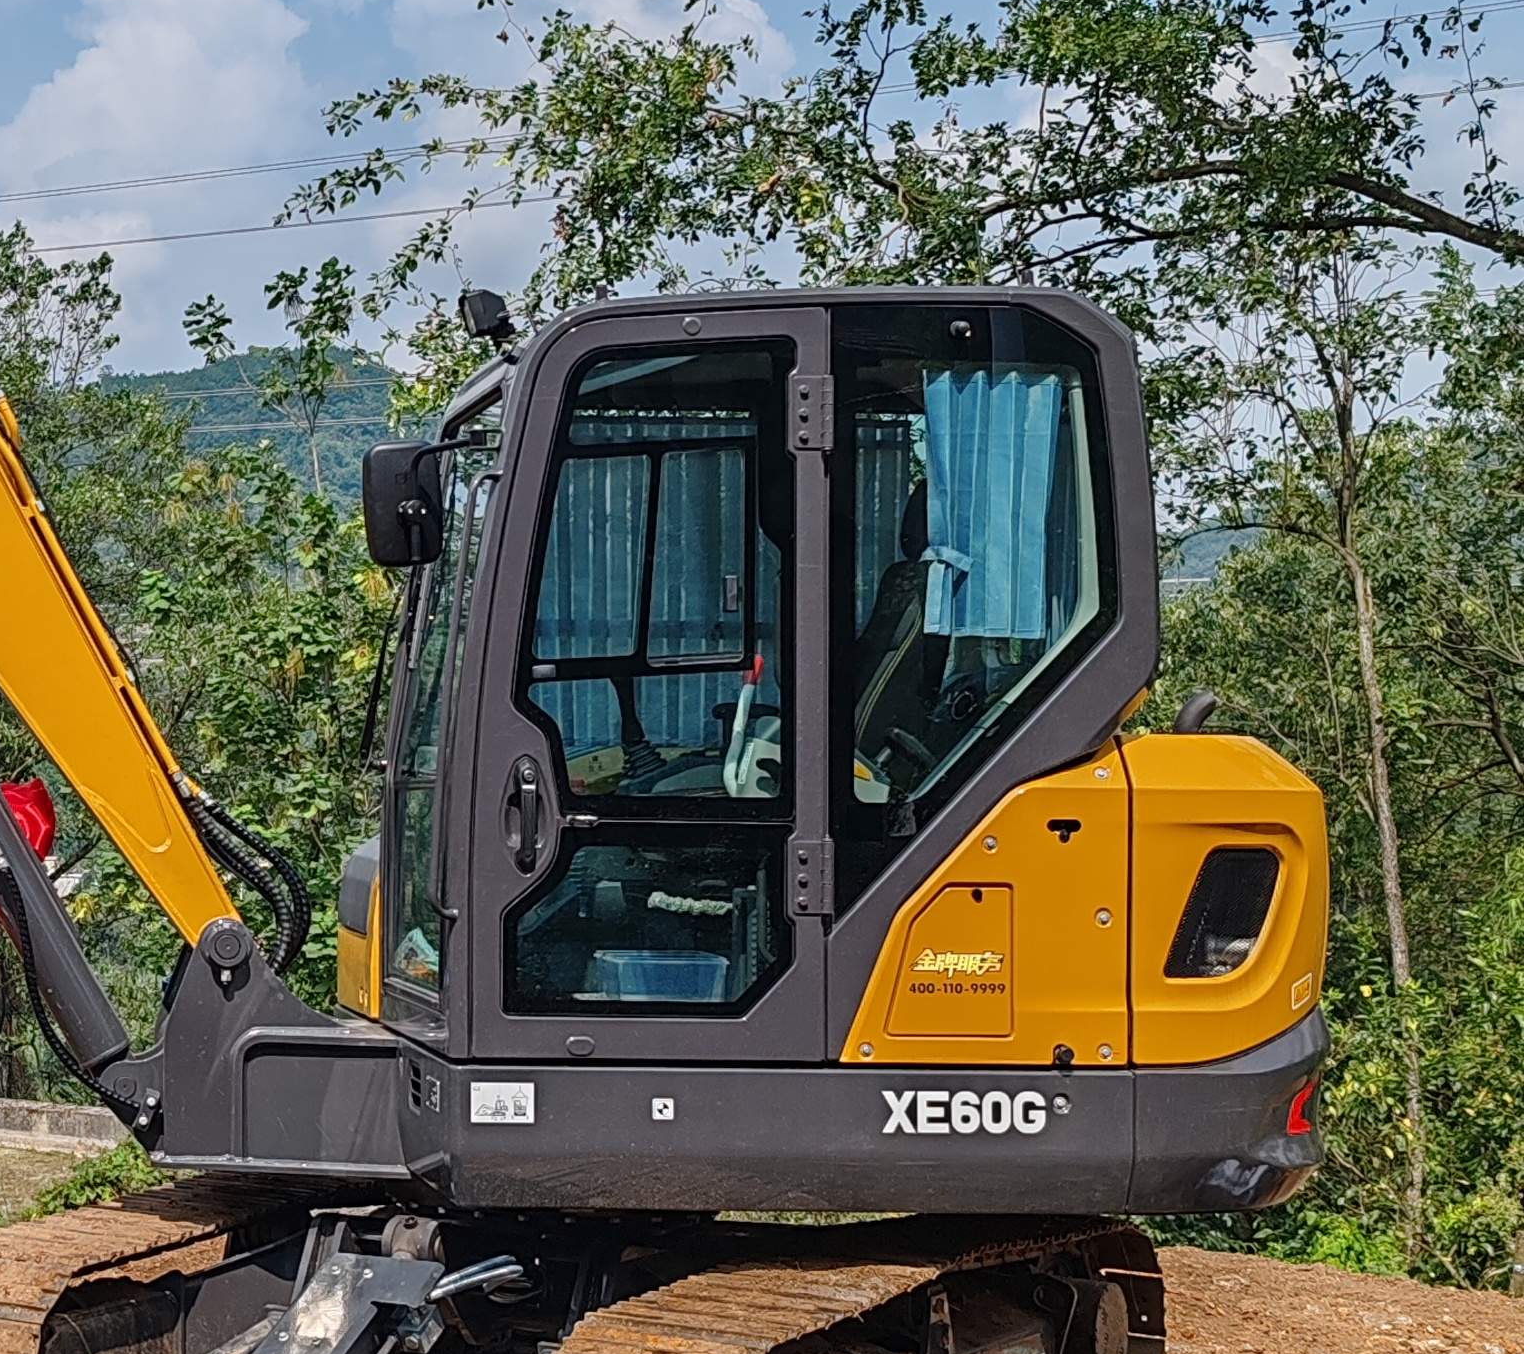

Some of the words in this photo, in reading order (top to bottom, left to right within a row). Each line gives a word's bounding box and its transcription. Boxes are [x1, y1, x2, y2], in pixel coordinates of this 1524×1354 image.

[911, 948, 1004, 978] 金牌服务
[909, 982, 1006, 995] 400-110-9999
[881, 1090, 1047, 1134] XE60G
